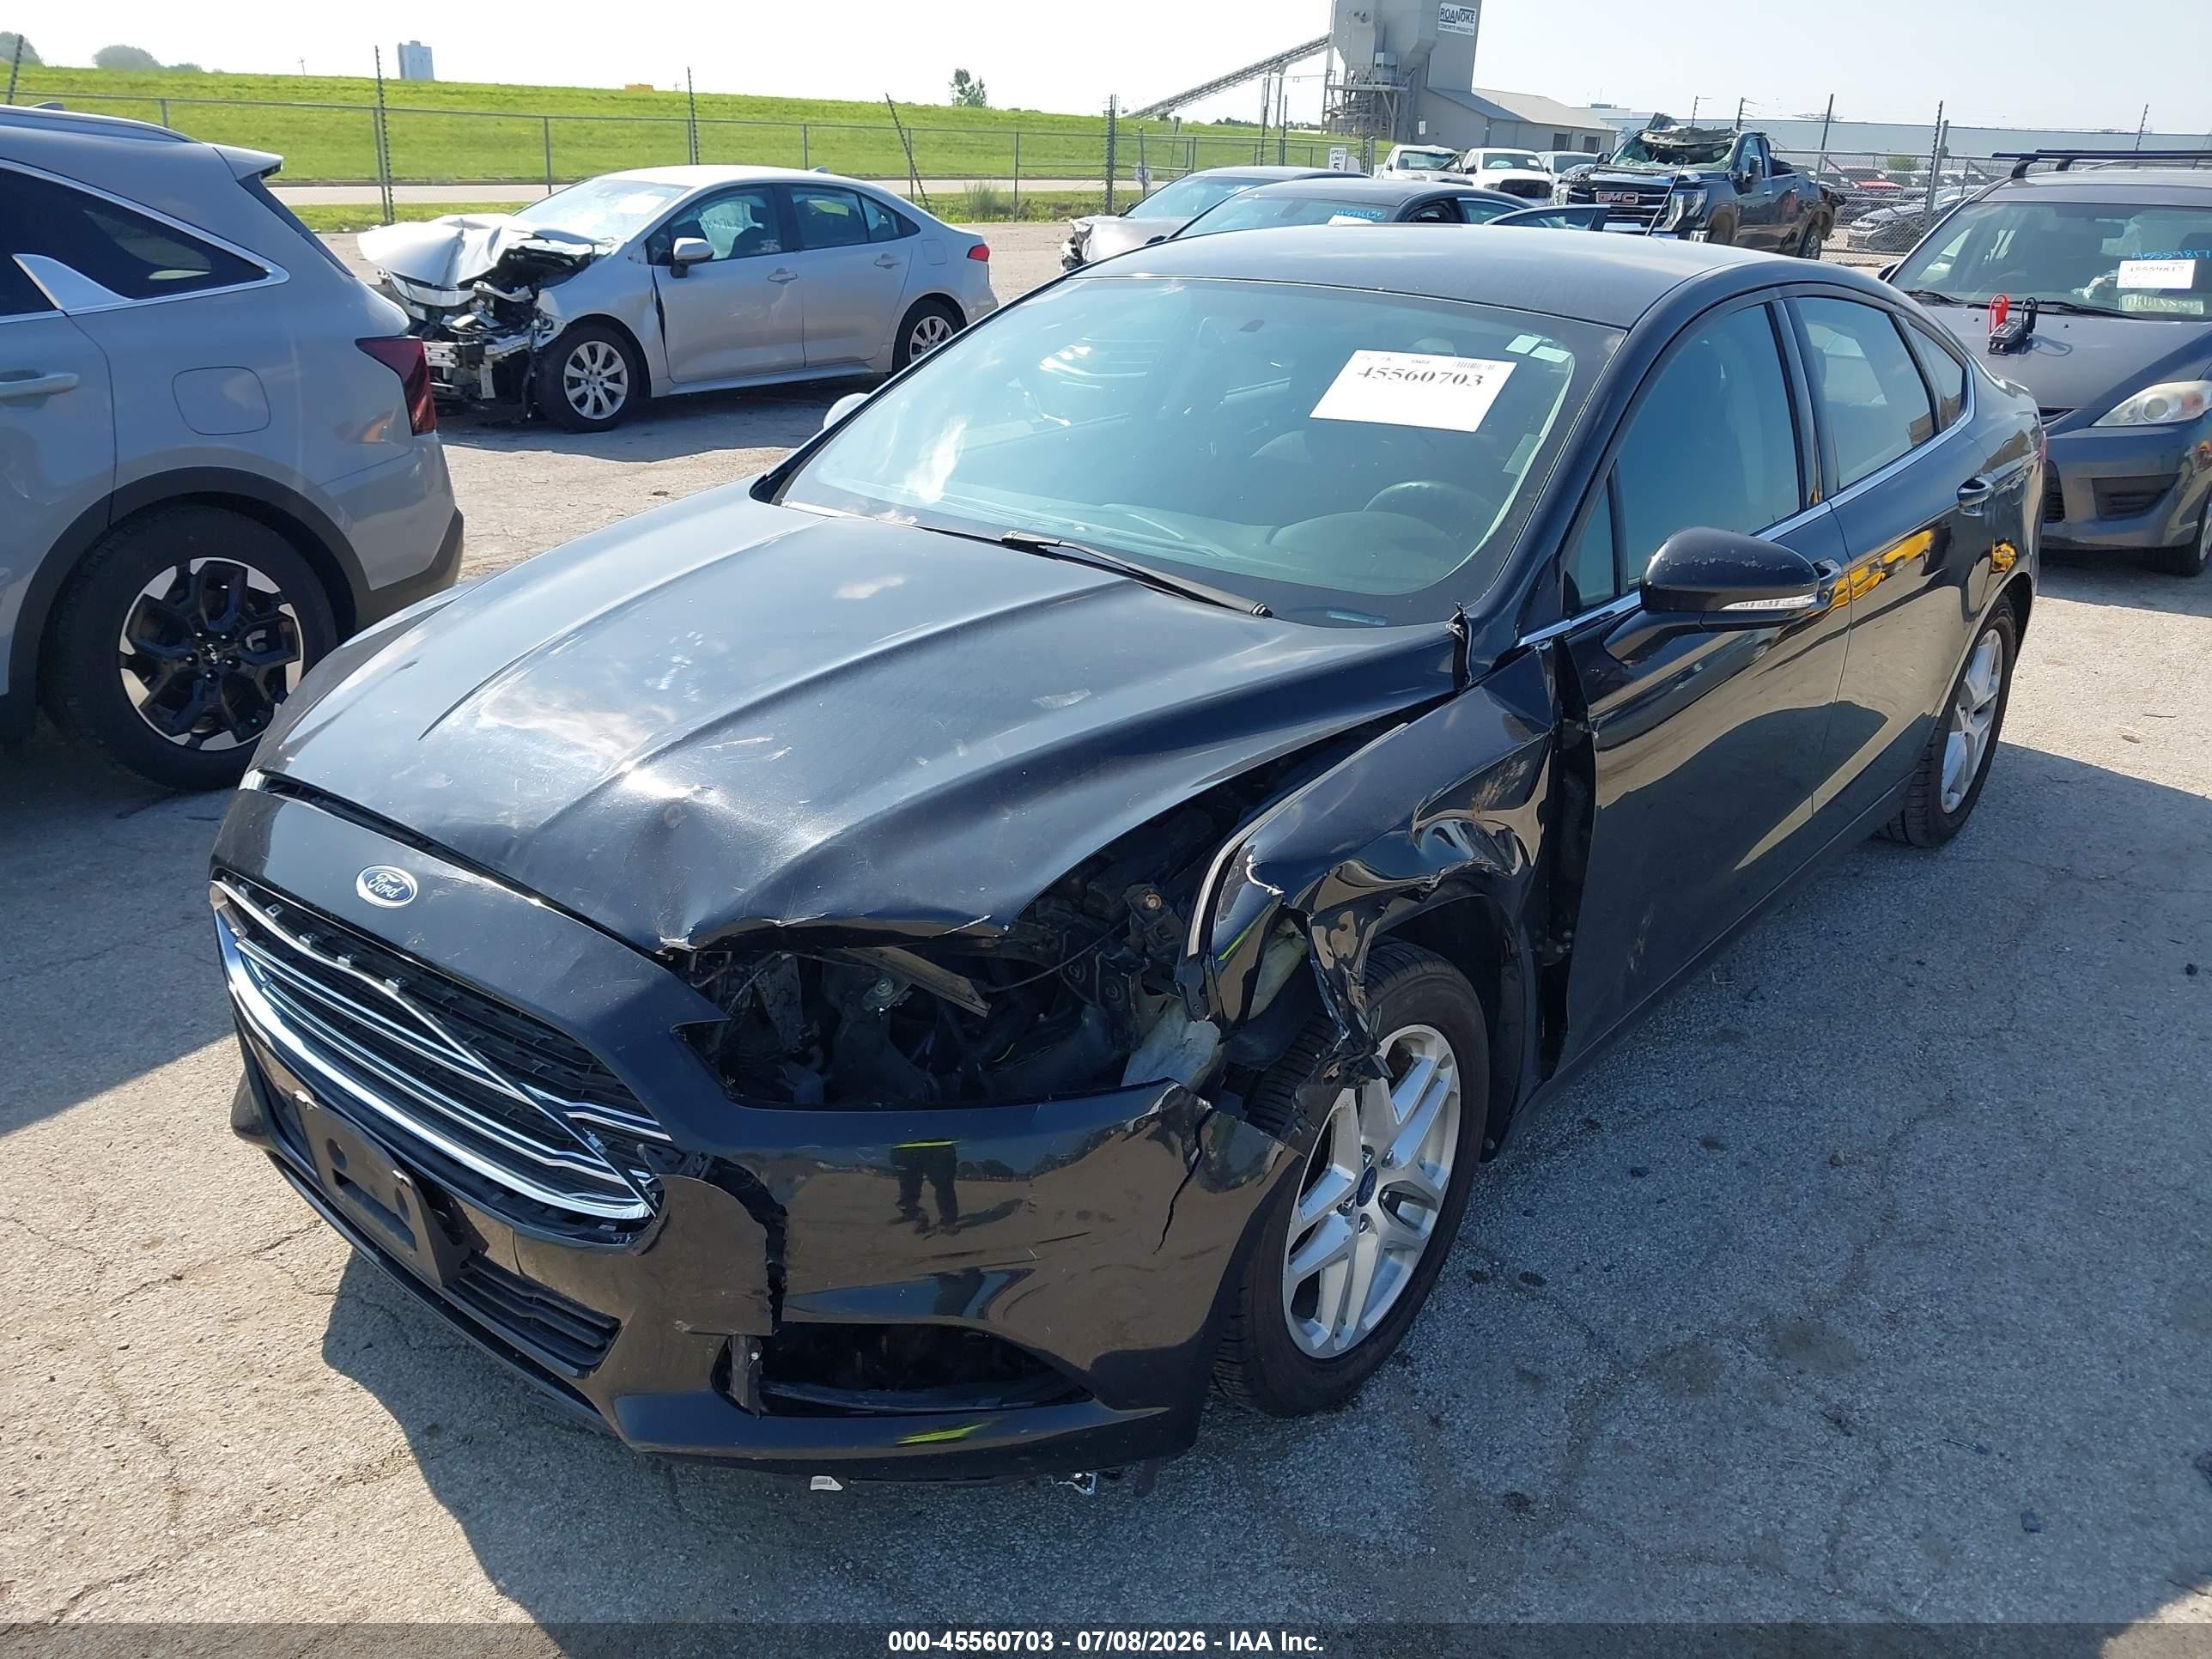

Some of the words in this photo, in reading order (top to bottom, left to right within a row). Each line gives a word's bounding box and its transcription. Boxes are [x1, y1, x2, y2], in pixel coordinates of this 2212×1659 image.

[1439, 8, 1475, 24] ROANOKE
[1333, 162, 1340, 172] 5
[1599, 191, 1636, 203] GMC
[2130, 249, 2211, 260] 45559817
[1357, 366, 1484, 387] 45560703
[367, 872, 405, 899] Ford
